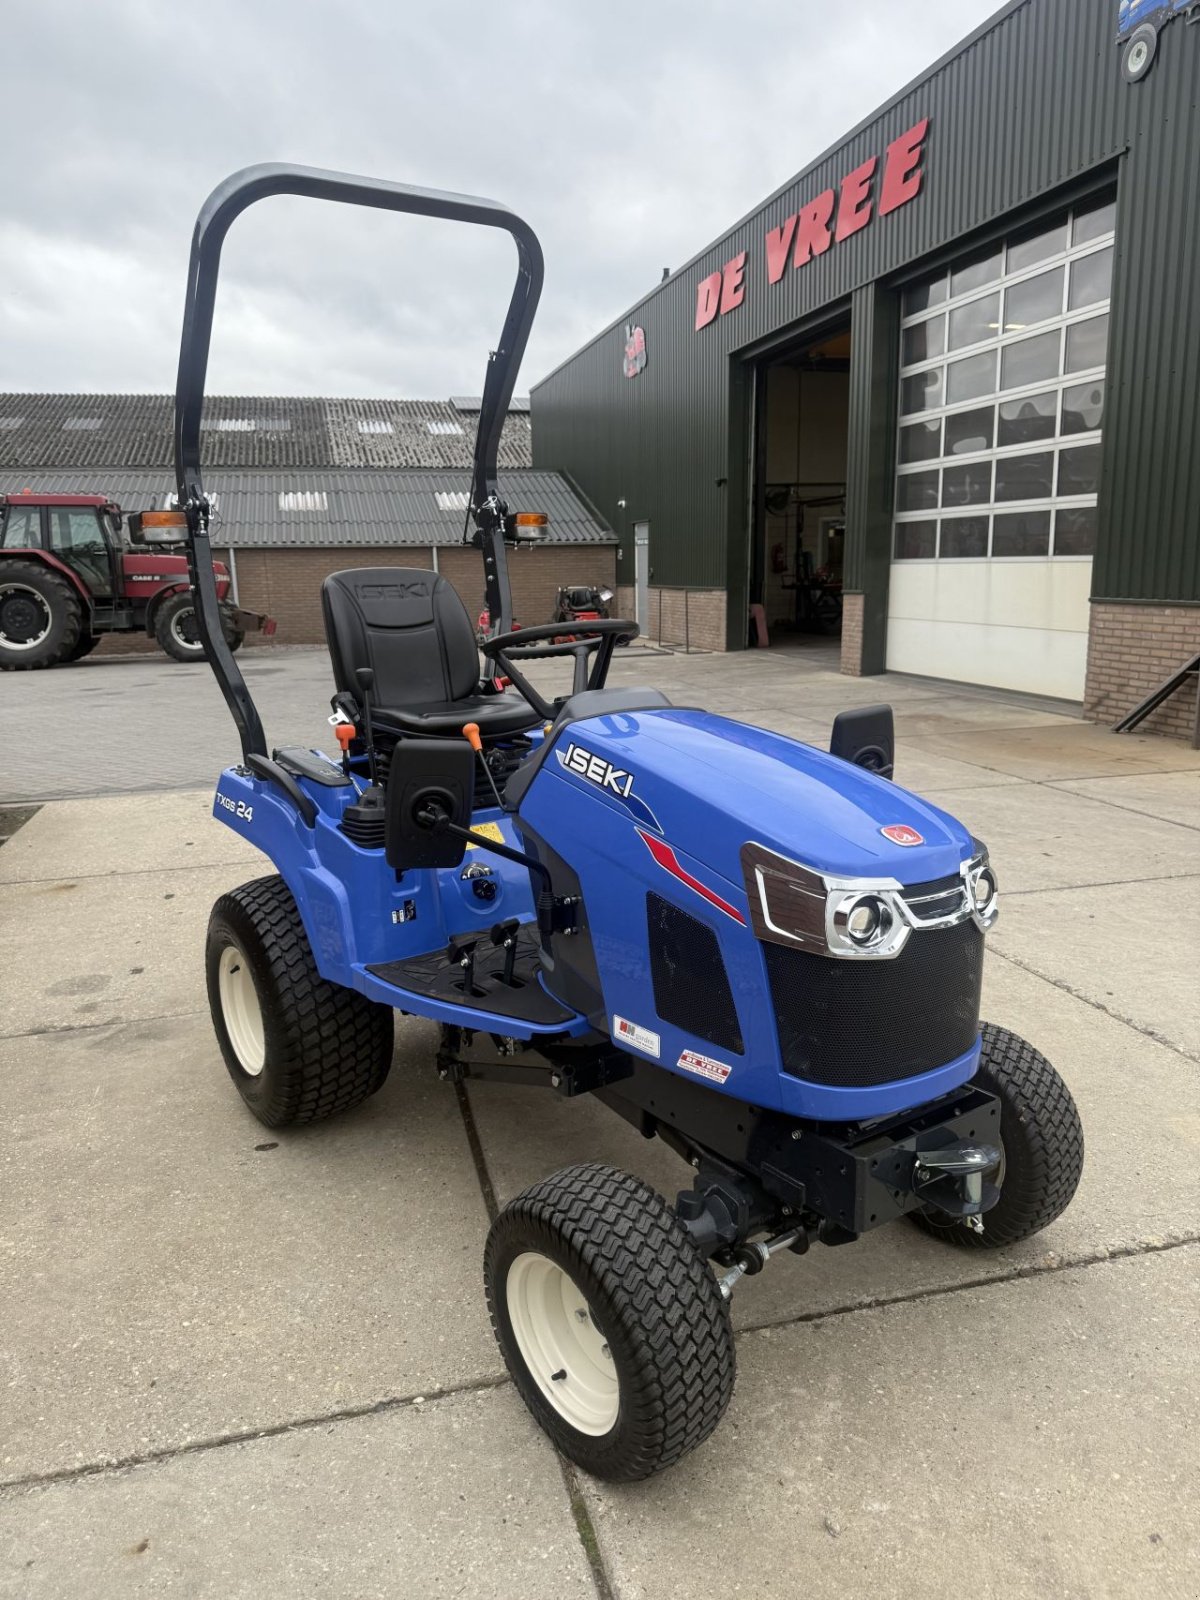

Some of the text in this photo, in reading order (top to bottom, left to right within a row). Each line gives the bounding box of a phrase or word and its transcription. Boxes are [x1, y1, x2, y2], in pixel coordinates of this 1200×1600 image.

[695, 117, 928, 332] DE VREE
[354, 583, 429, 601] ISEKI
[563, 742, 635, 799] ISEKI
[216, 792, 253, 823] TXGS 24
